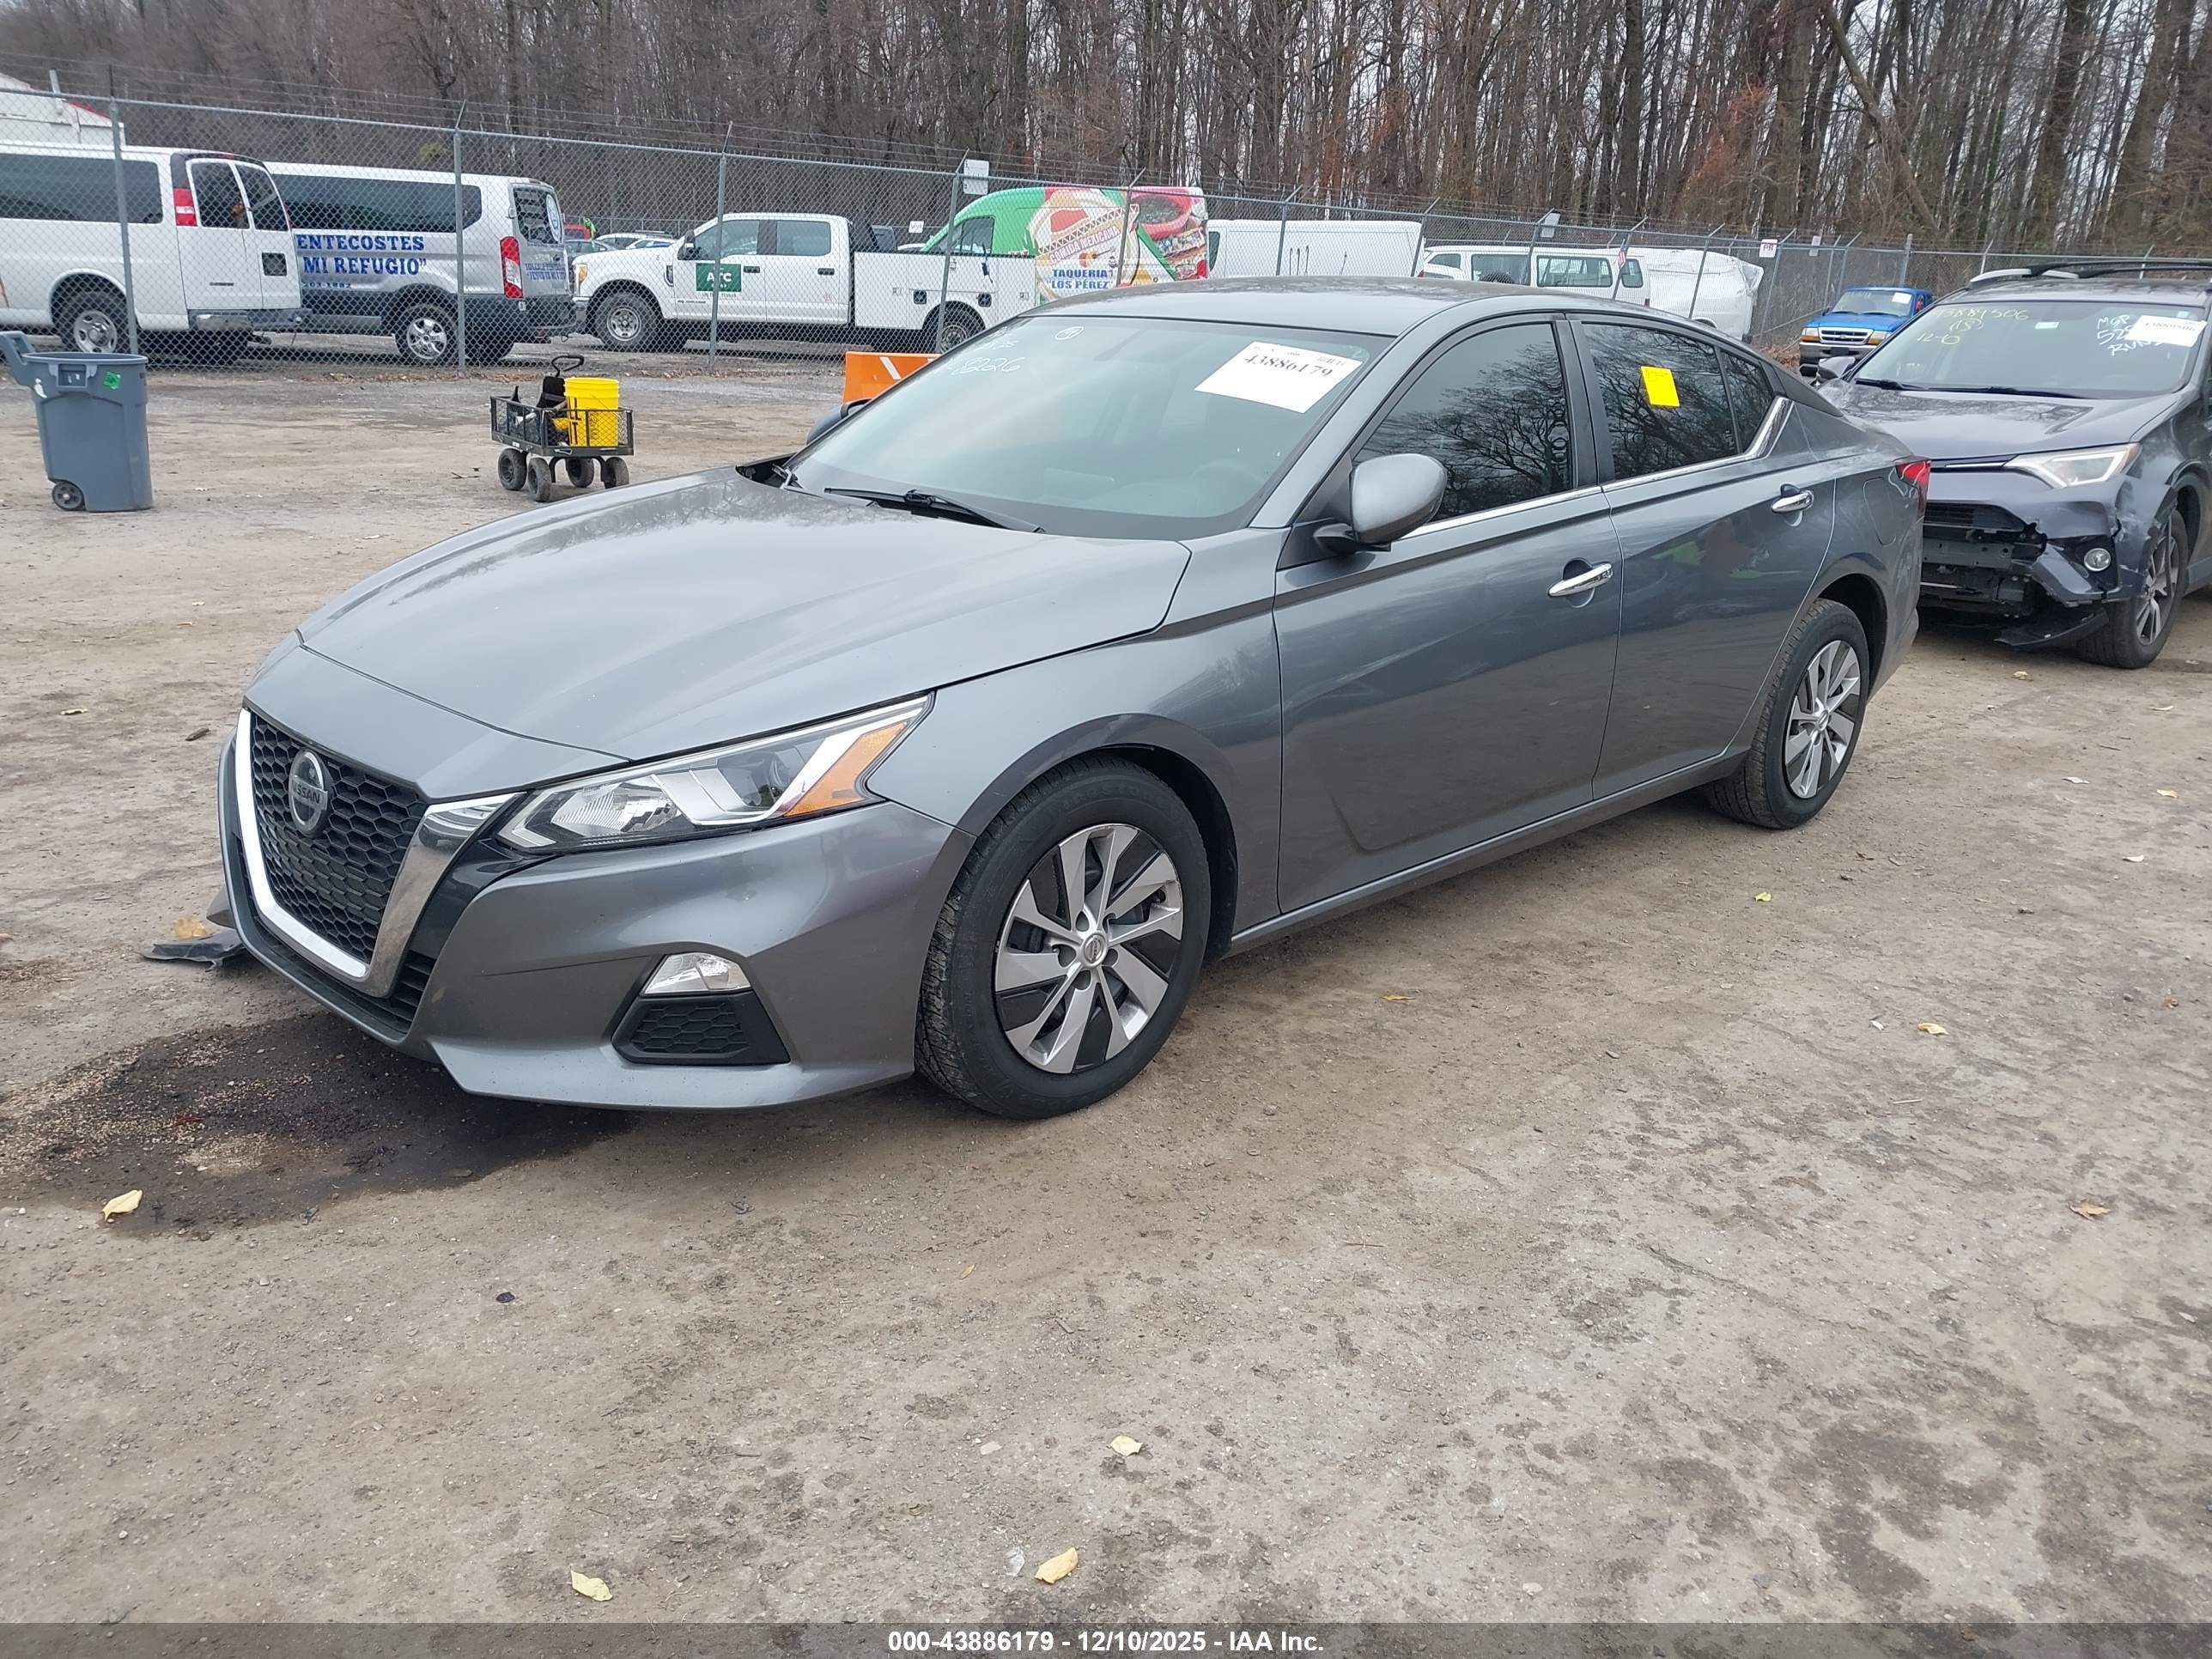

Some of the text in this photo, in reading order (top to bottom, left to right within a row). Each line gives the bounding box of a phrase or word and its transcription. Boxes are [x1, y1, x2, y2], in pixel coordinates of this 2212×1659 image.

[302, 257, 329, 274] MI
[1052, 269, 1109, 278] TAQUERIA
[1243, 355, 1334, 376] 43886179
